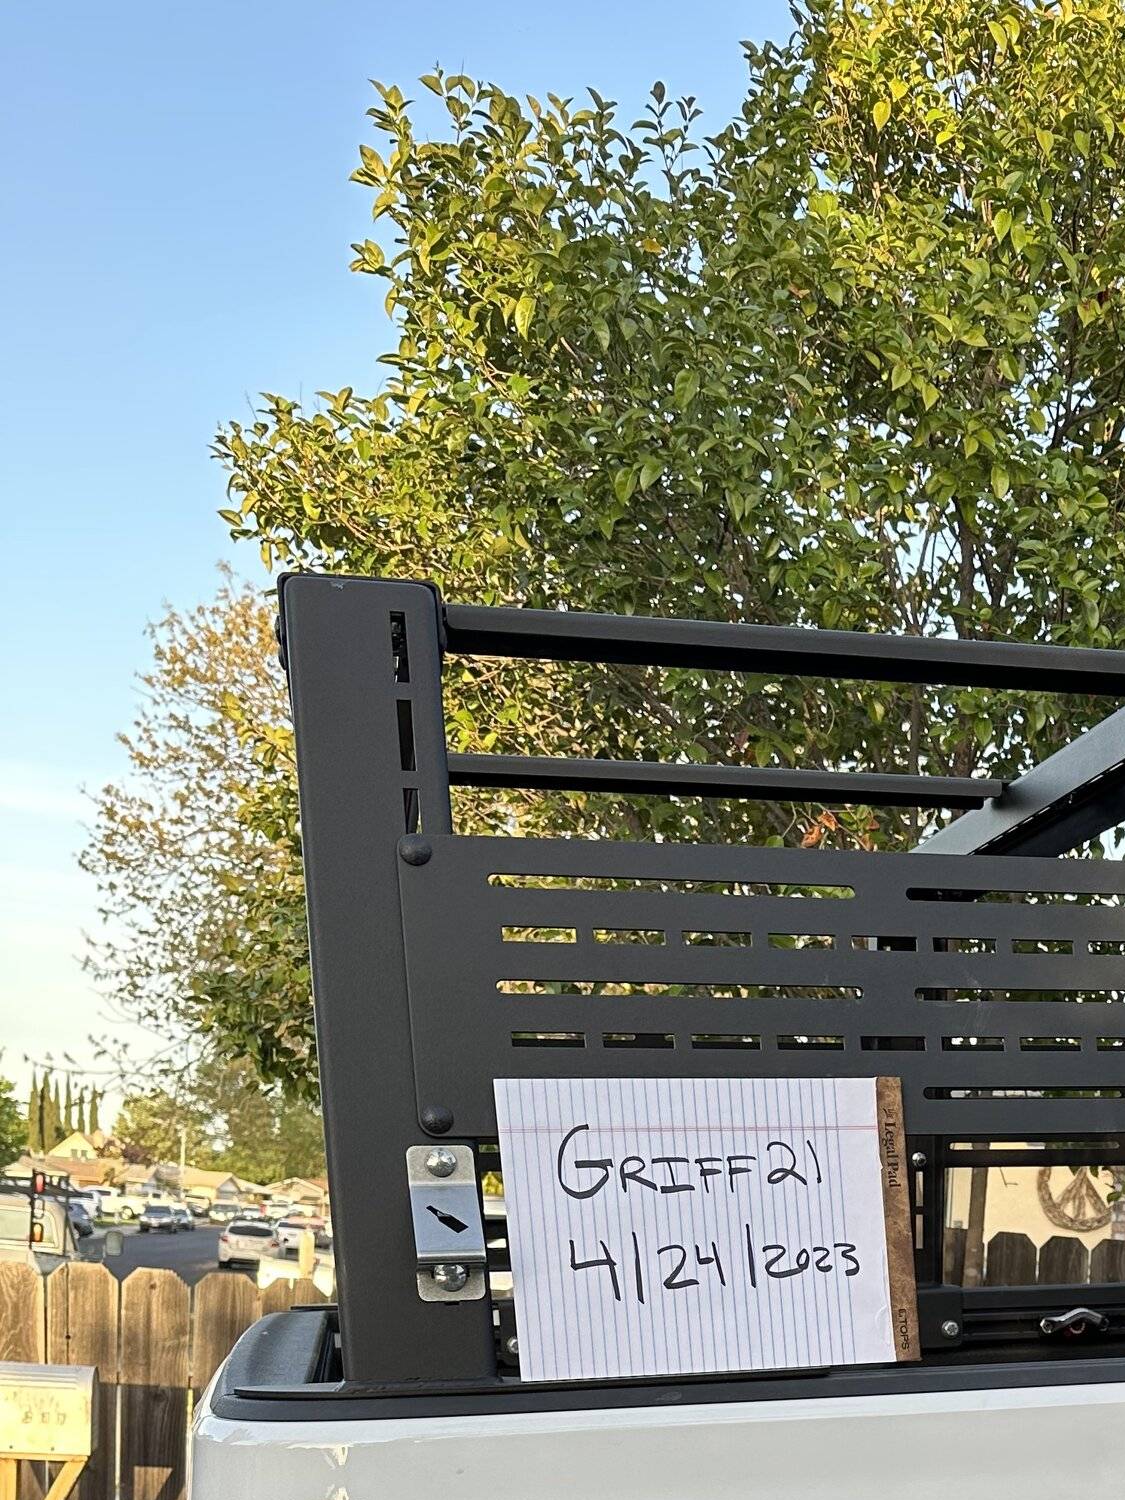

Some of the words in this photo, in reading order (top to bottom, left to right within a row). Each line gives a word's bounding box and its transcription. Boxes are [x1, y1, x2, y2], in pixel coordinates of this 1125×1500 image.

[882, 1121, 899, 1159] Legal
[887, 1160, 902, 1189] Pad
[568, 1224, 862, 1304] 4/24/2023
